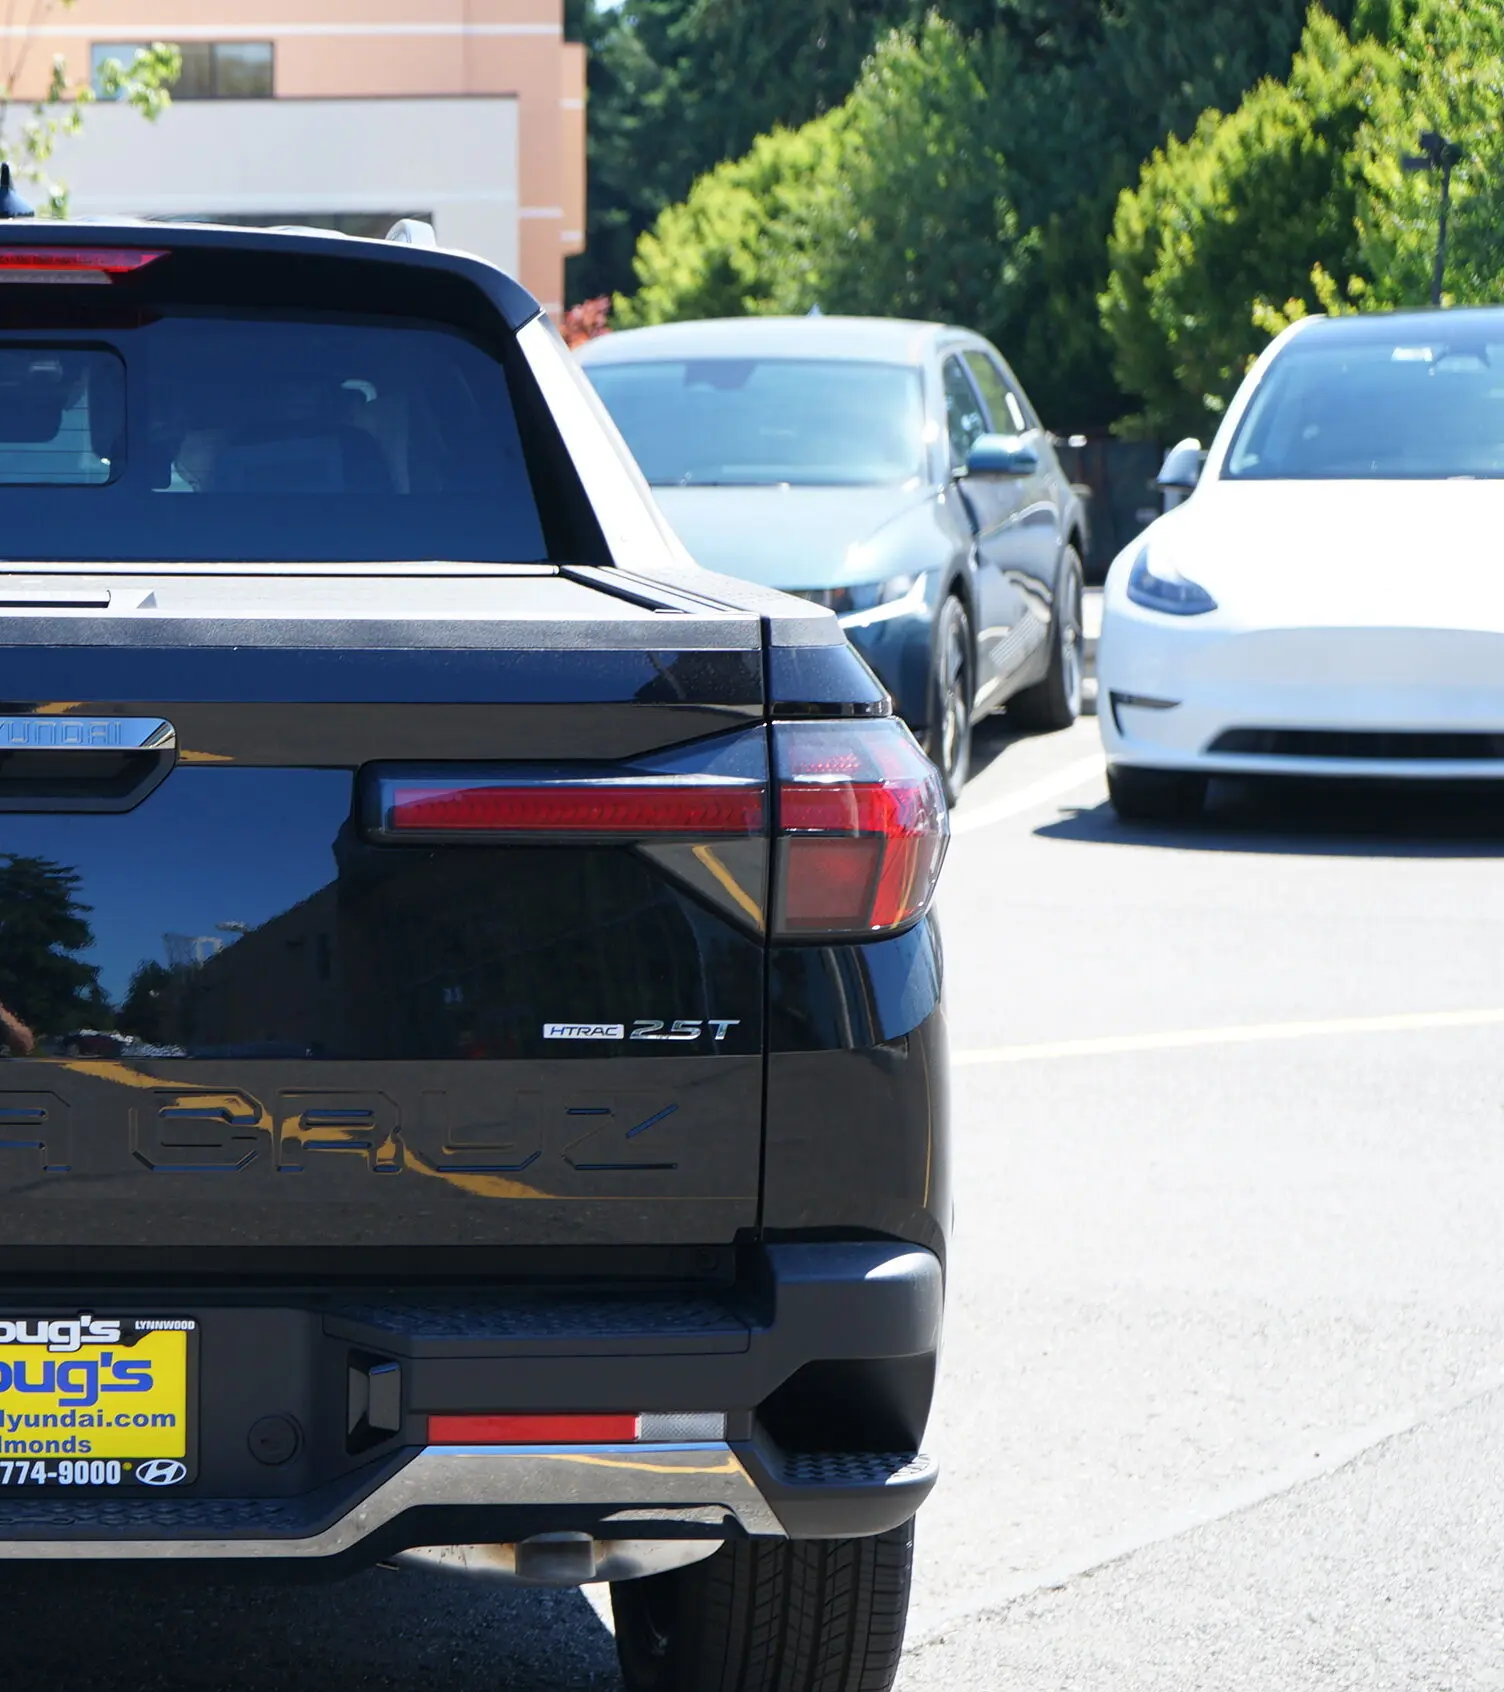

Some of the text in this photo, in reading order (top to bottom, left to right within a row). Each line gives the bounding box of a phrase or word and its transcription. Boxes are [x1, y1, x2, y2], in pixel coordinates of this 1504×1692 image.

[550, 1026, 618, 1036] HTRAC
[129, 1086, 679, 1173] CRUZ
[134, 1320, 196, 1331] LYNNWOOD
